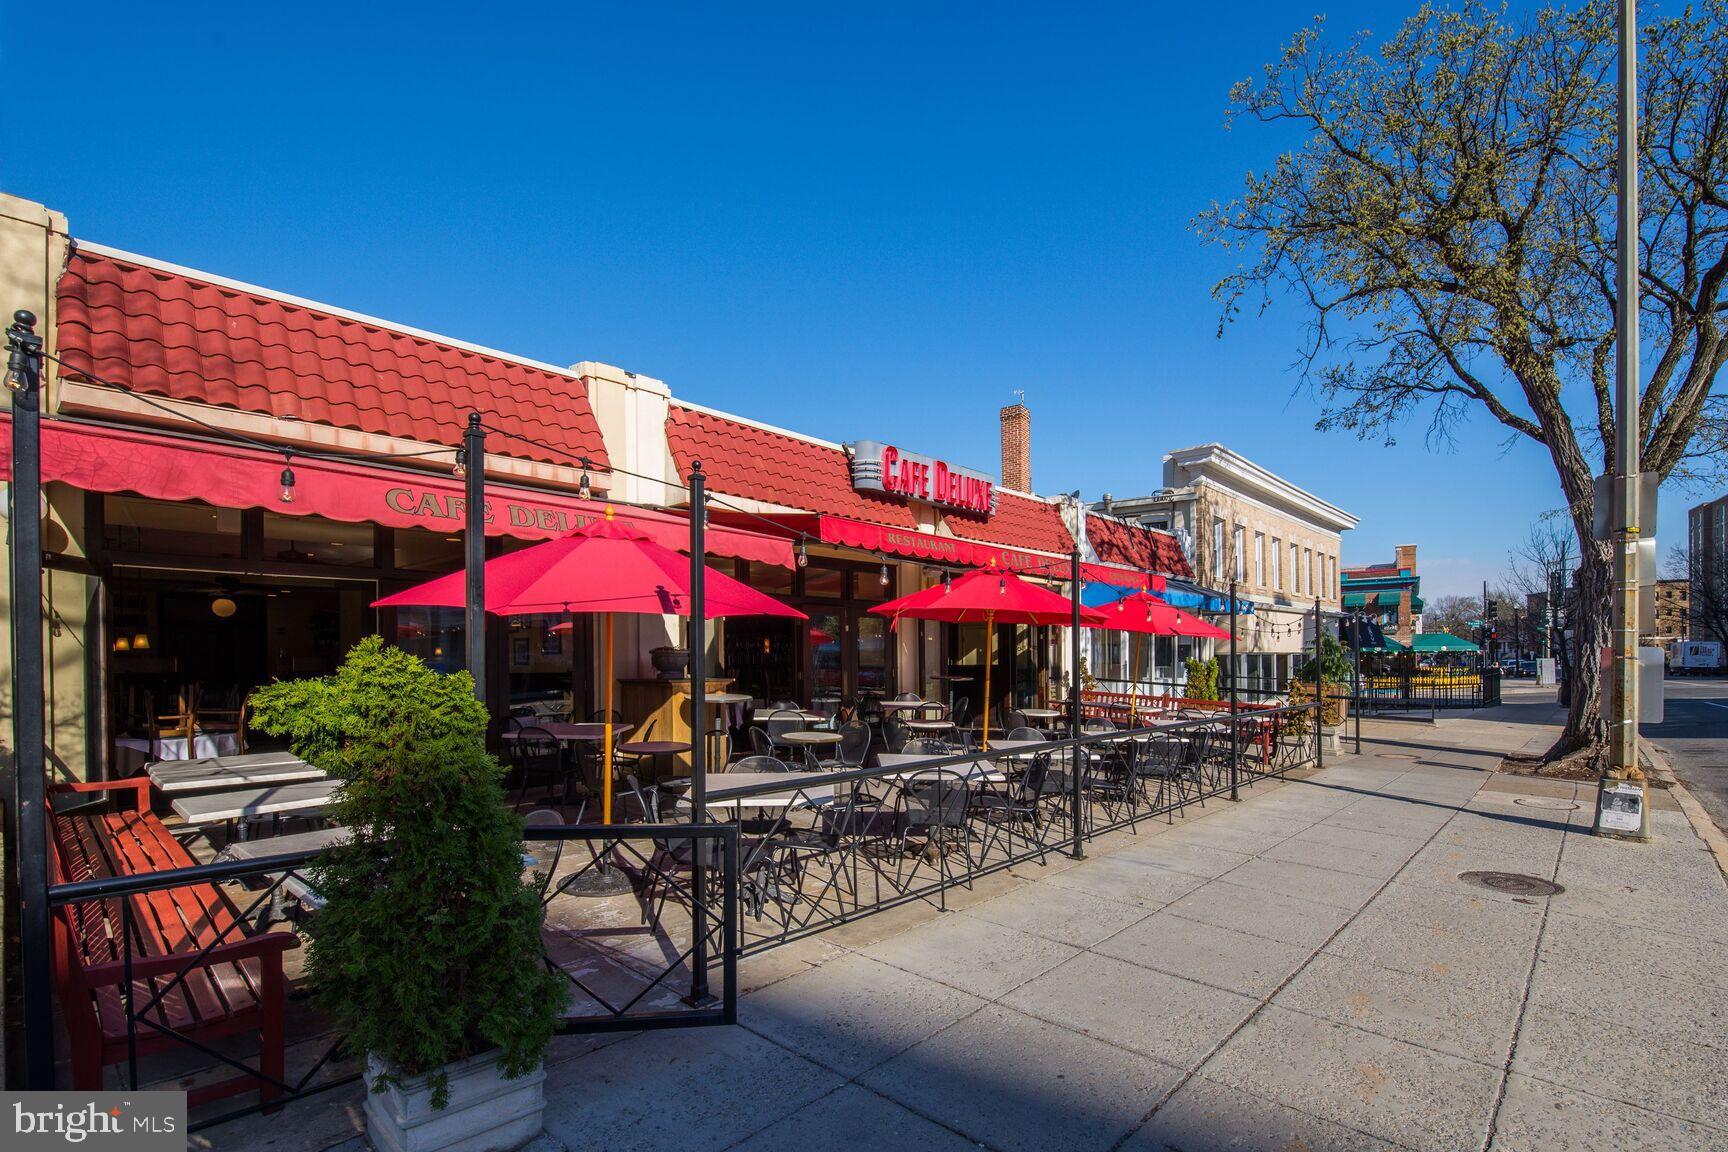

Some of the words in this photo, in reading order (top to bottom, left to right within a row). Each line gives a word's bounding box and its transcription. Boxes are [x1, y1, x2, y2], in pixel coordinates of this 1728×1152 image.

[882, 446, 929, 500] CAFE
[934, 460, 993, 513] DELUXE
[887, 533, 957, 554] RESTAURANT
[1001, 551, 1032, 569] CAFE
